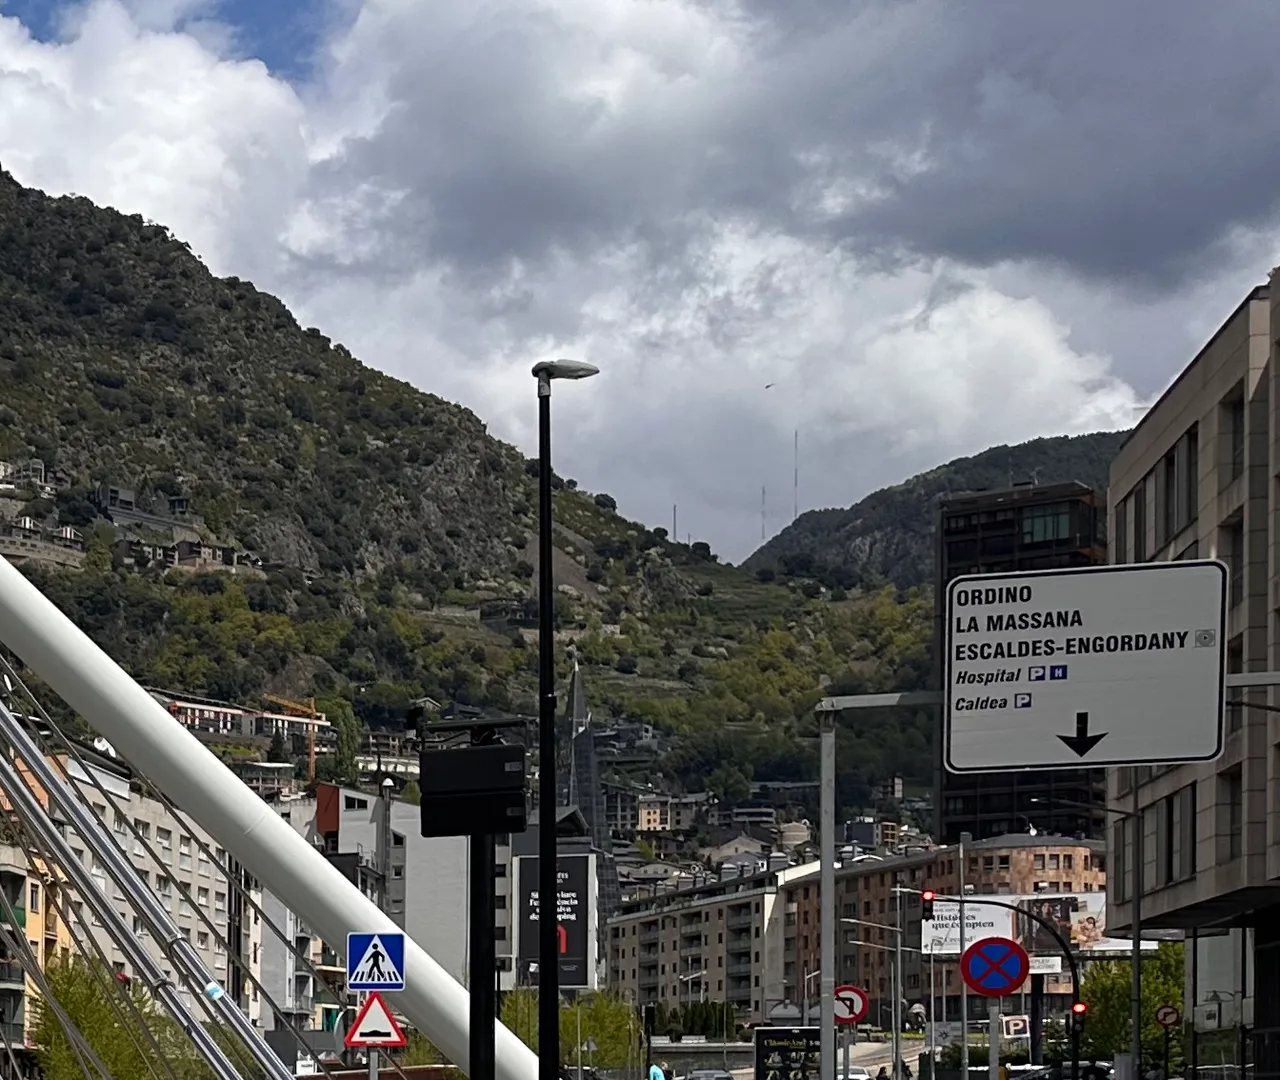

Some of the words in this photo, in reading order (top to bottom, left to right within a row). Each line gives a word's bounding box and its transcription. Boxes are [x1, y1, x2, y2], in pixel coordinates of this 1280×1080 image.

[956, 585, 1032, 607] ORDINO
[955, 615, 979, 633] LA
[986, 610, 1083, 631] MASSANA
[955, 631, 1189, 661] ESCALDES-ENGORDANY
[956, 668, 1021, 686] Hospital
[955, 697, 1008, 711] Caldea
